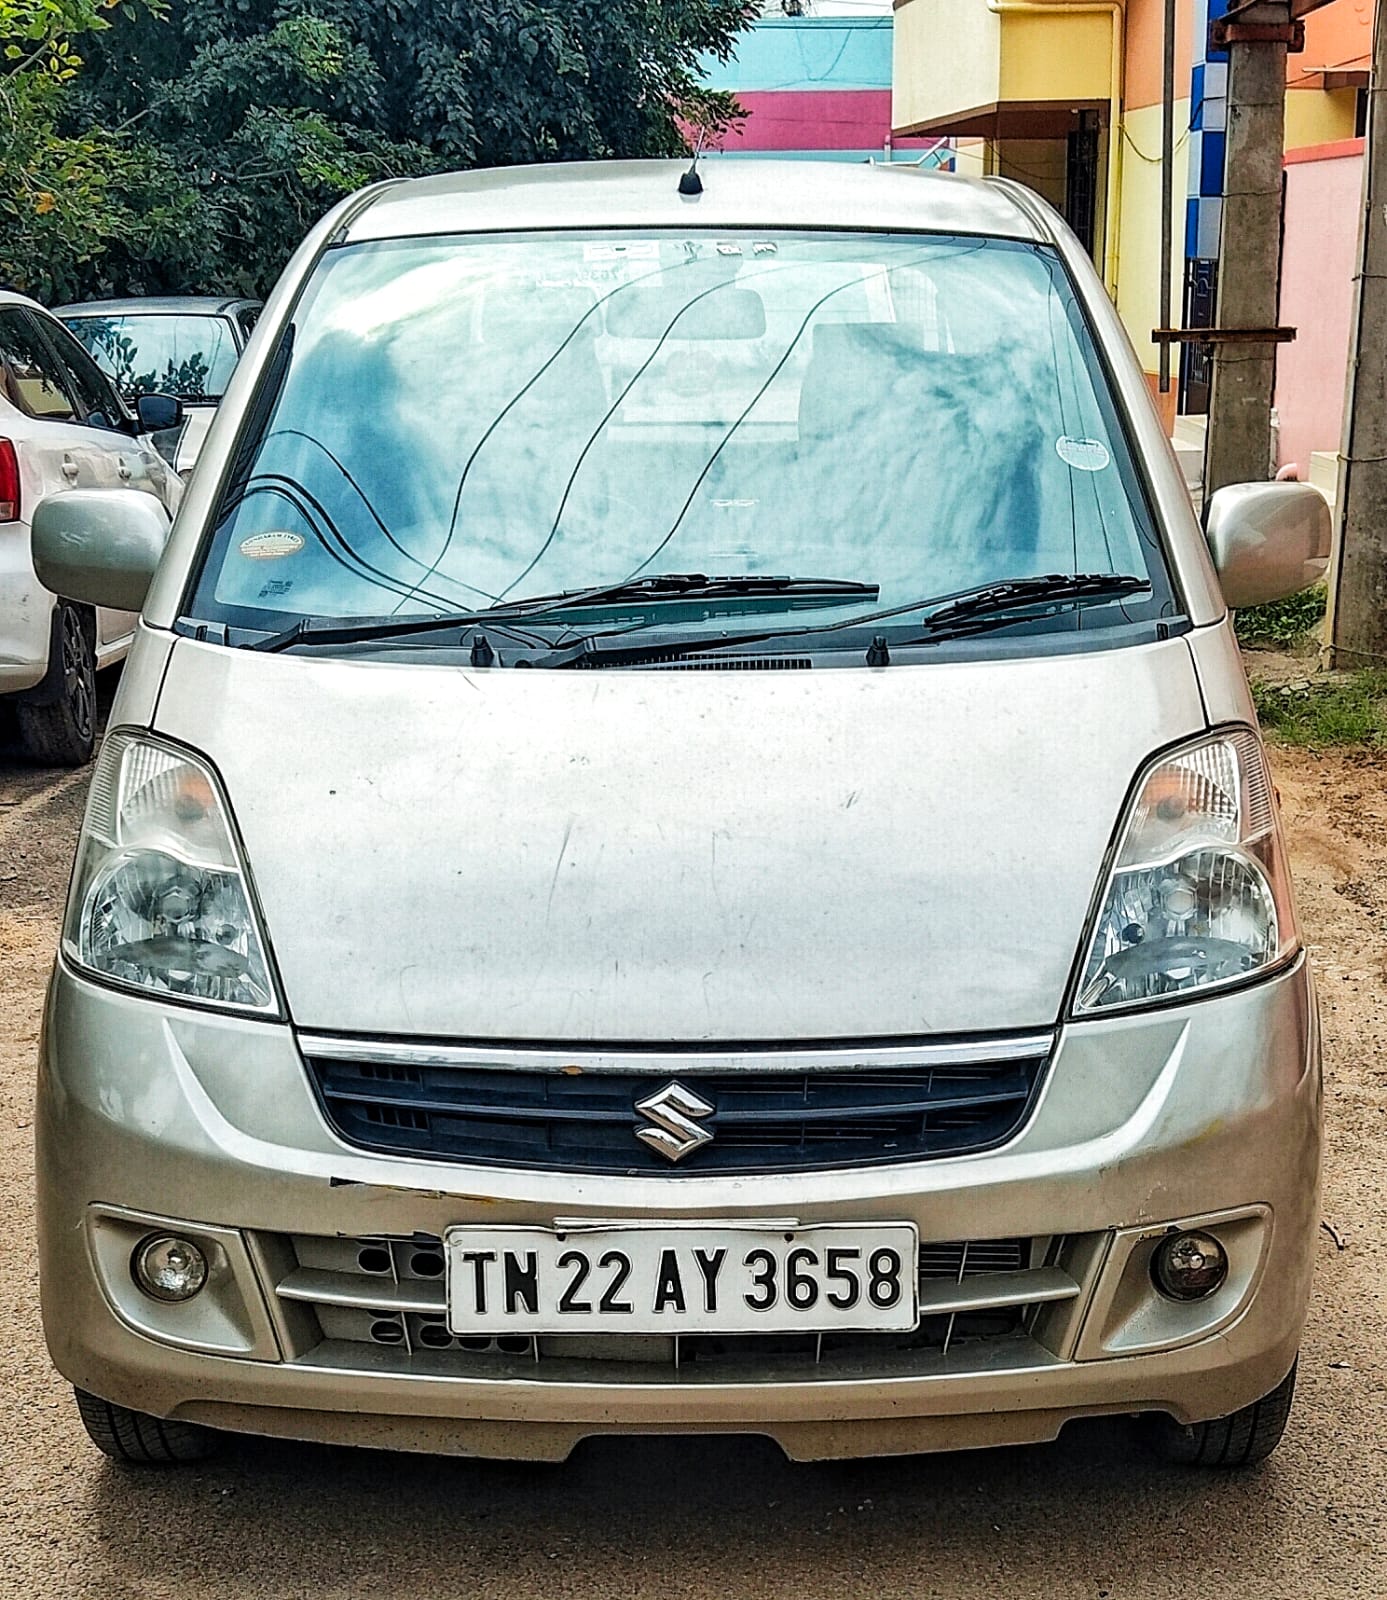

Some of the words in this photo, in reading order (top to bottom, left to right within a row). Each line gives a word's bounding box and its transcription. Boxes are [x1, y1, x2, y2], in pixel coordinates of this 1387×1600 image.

[462, 1249, 539, 1314] TN
[555, 1249, 634, 1314] 22
[652, 1248, 729, 1314] AY
[742, 1247, 902, 1312] 3658
